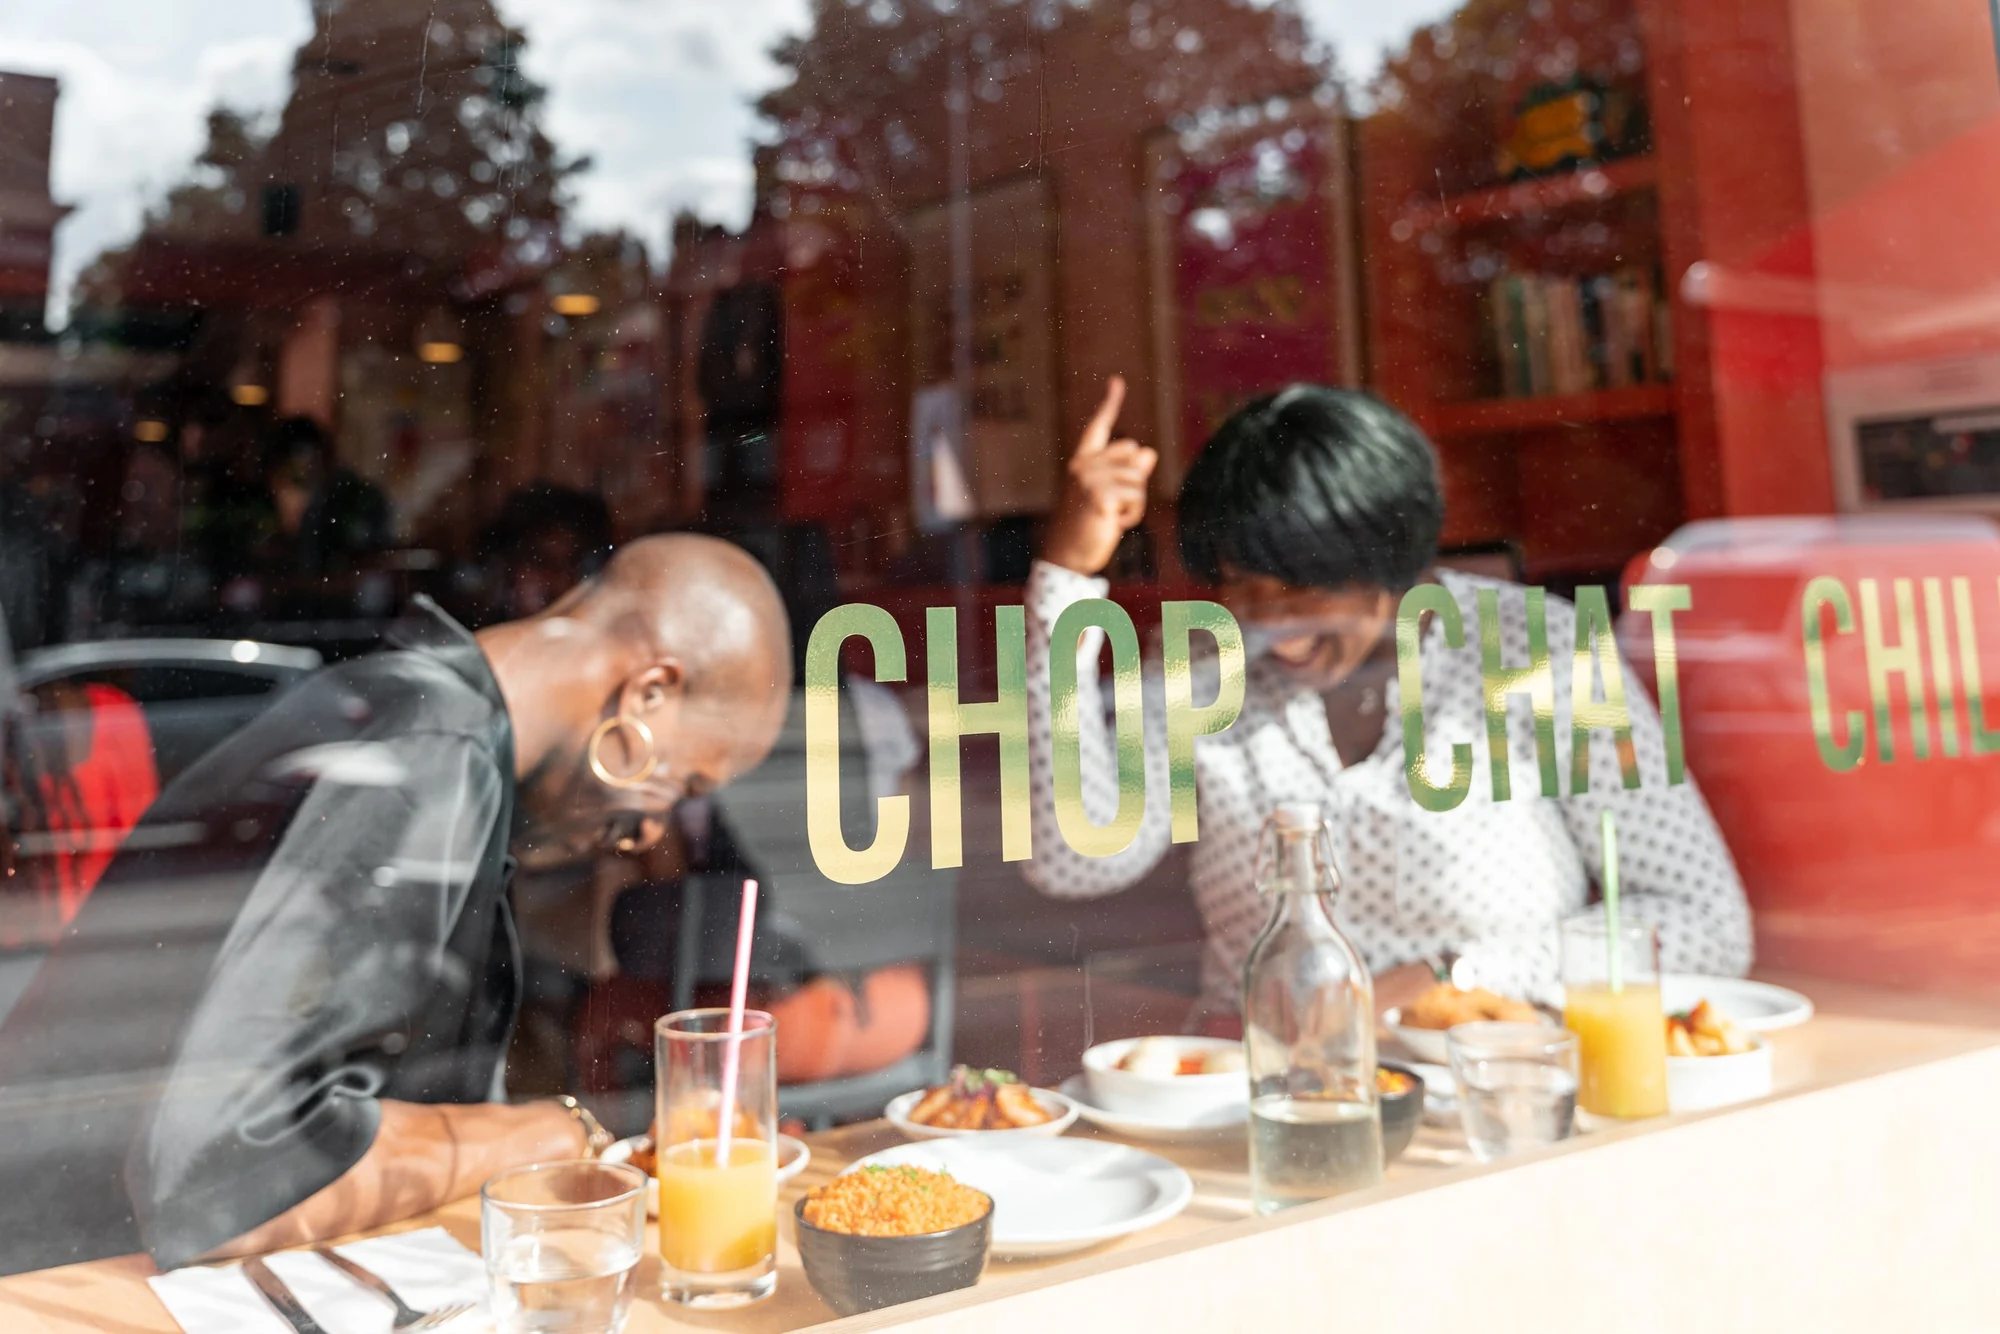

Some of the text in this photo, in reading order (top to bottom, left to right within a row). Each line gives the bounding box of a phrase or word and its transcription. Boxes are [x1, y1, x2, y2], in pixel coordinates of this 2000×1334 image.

[805, 576, 2000, 884] CHOP CHAT CHIL
